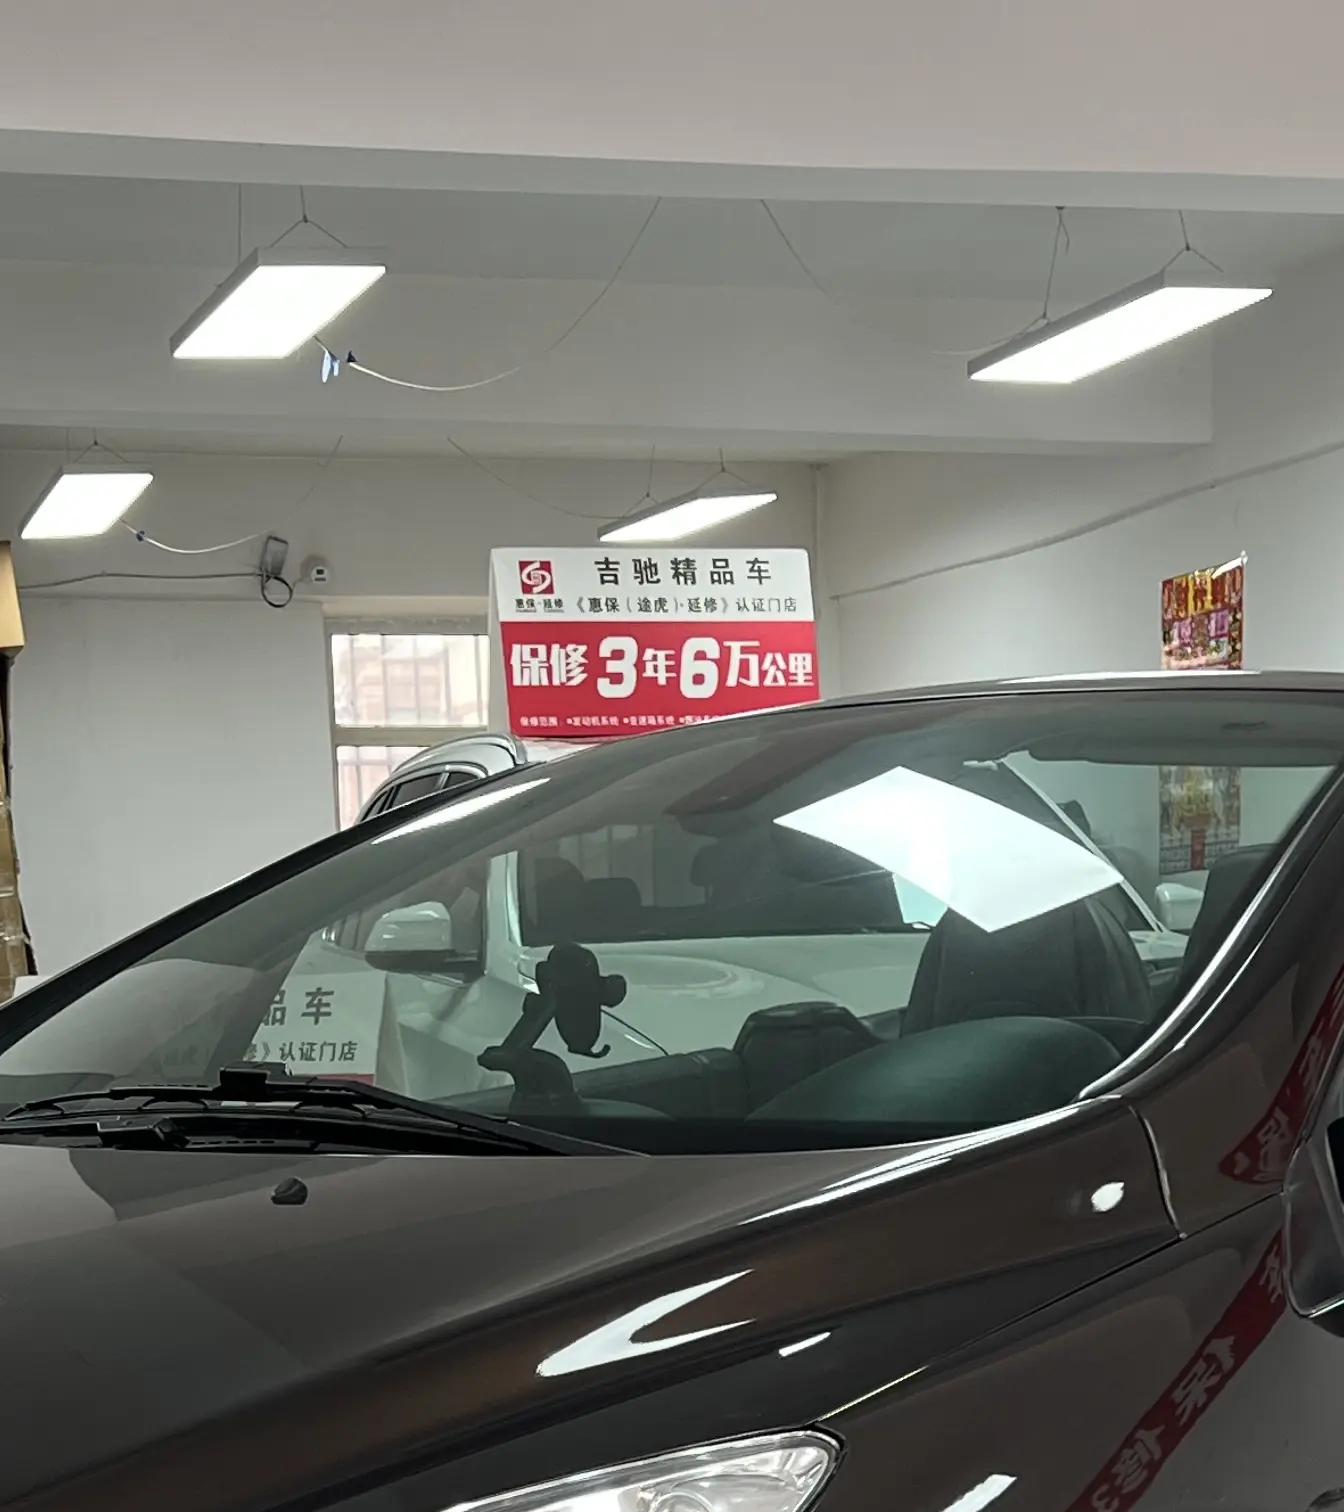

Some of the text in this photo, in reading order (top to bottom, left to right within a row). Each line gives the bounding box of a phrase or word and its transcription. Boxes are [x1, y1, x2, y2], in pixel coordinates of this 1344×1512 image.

[593, 556, 772, 587] 吉驰精品车
[510, 635, 815, 700] 保修3年6万公里
